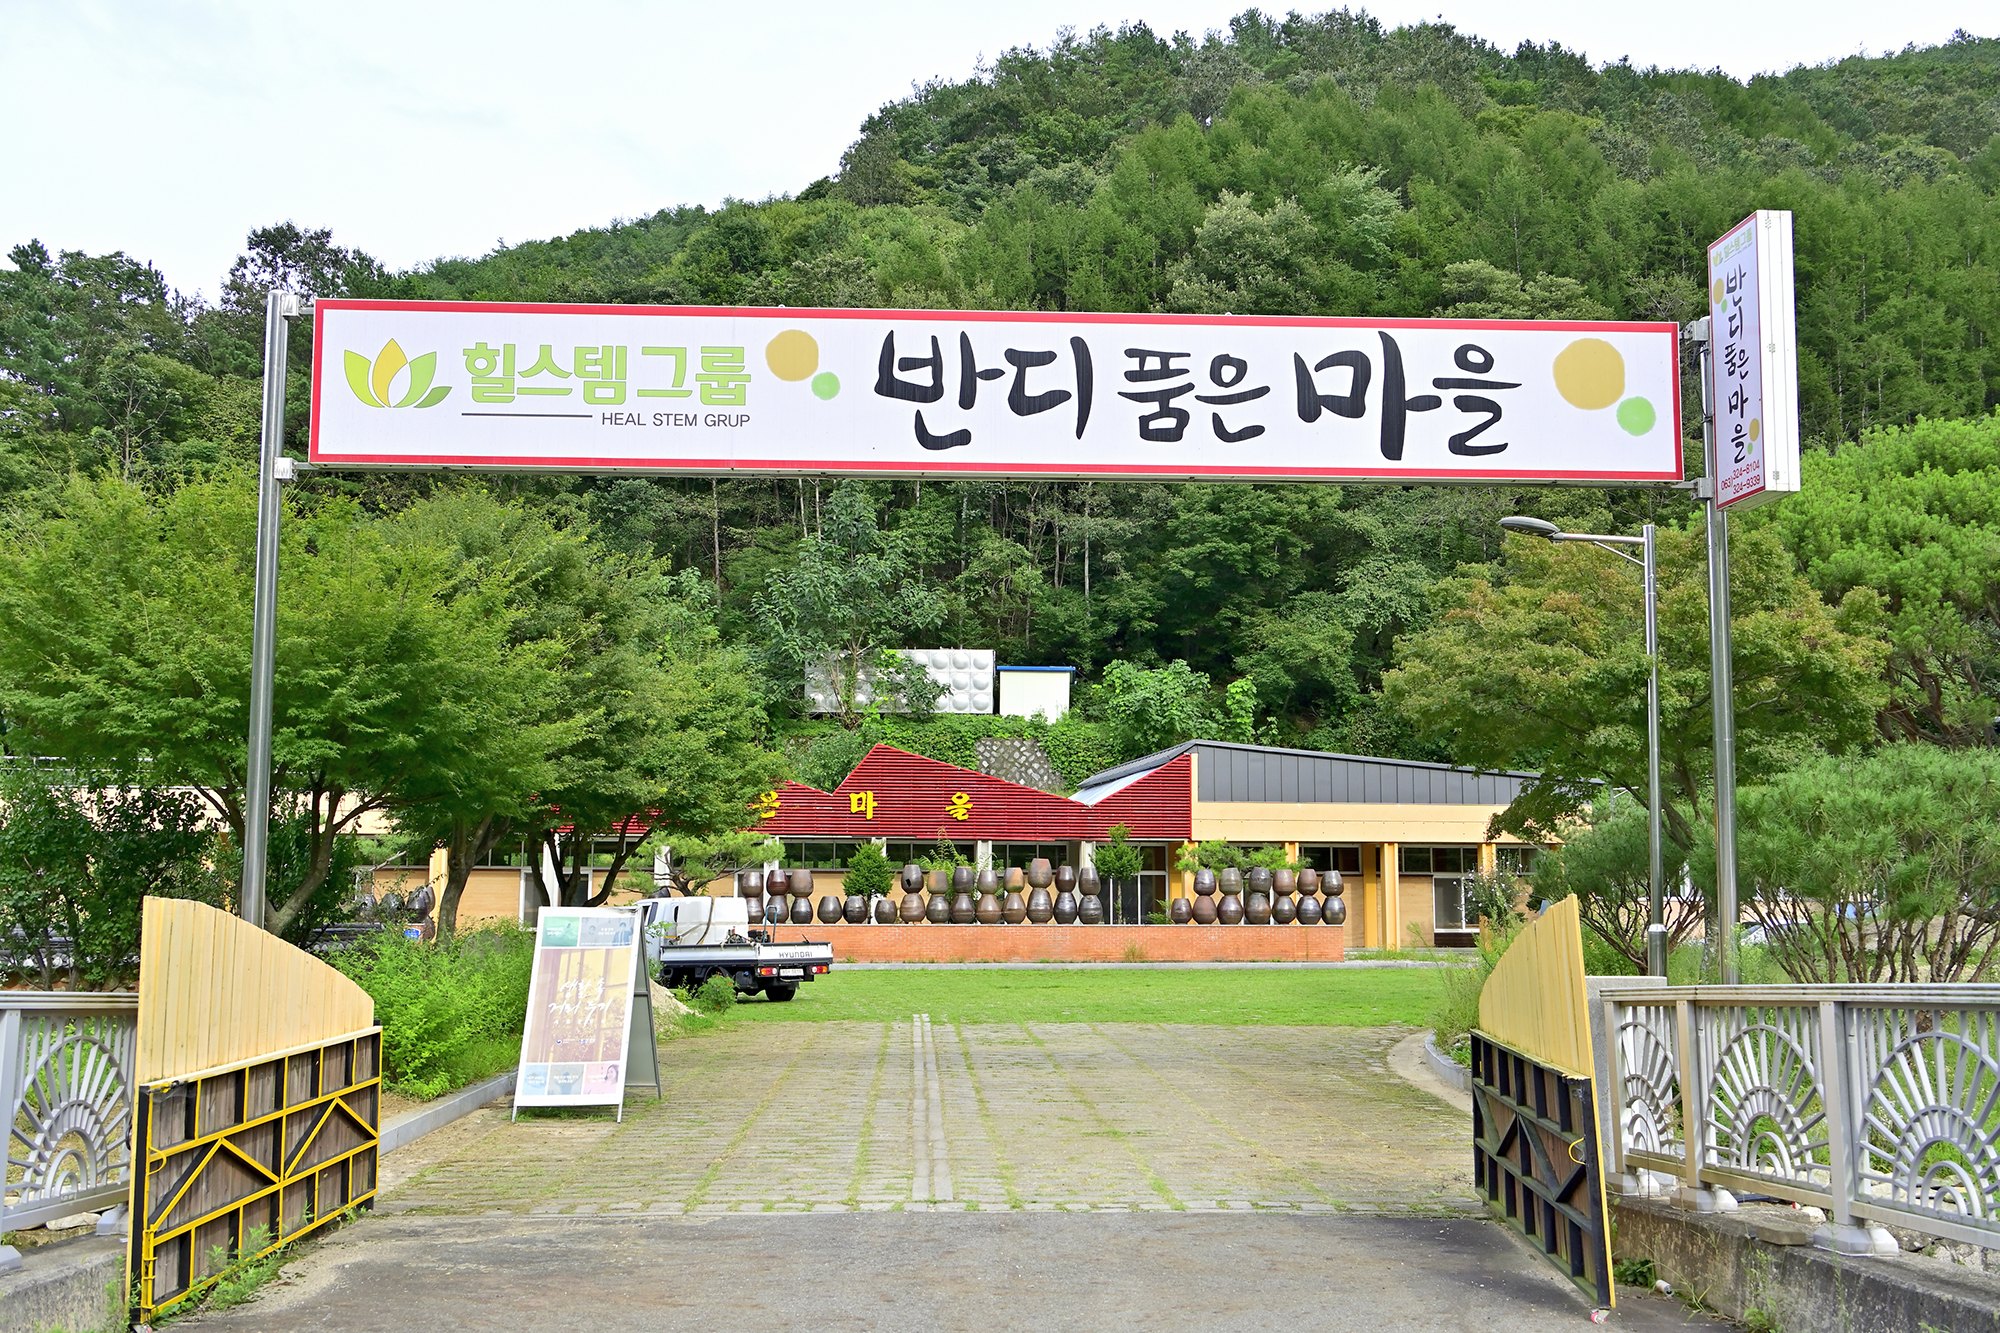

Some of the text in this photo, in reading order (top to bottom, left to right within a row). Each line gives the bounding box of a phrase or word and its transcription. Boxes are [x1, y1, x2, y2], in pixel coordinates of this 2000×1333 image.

[1726, 263, 1747, 340] 반디
[462, 342, 752, 406] 힐스템그룹
[1724, 342, 1749, 380] 품은
[602, 412, 751, 428] HEAL STEM GRUP
[874, 330, 1523, 461] 반디 품은 마을
[1728, 383, 1749, 464] 마을
[778, 951, 813, 959] HYUNDAI
